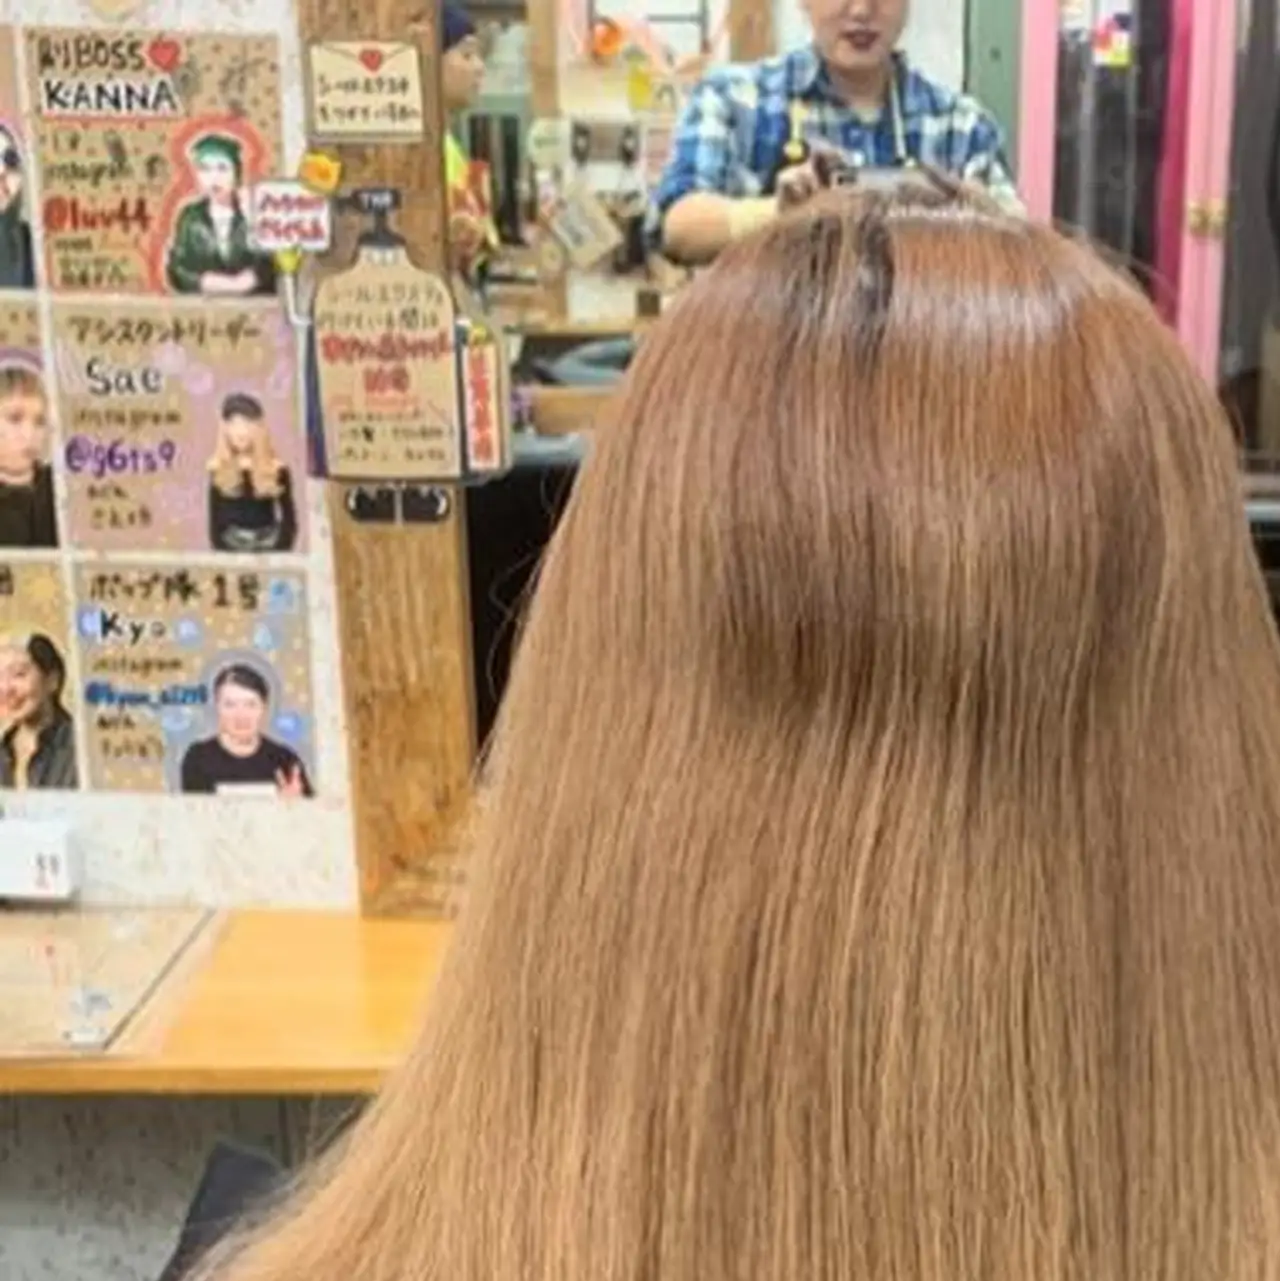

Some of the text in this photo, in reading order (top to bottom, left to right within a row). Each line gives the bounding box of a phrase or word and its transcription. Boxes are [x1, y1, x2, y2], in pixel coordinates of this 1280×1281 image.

[44, 80, 178, 110] KANNA
[86, 357, 162, 396] Sae
[101, 609, 165, 646] Kyo
